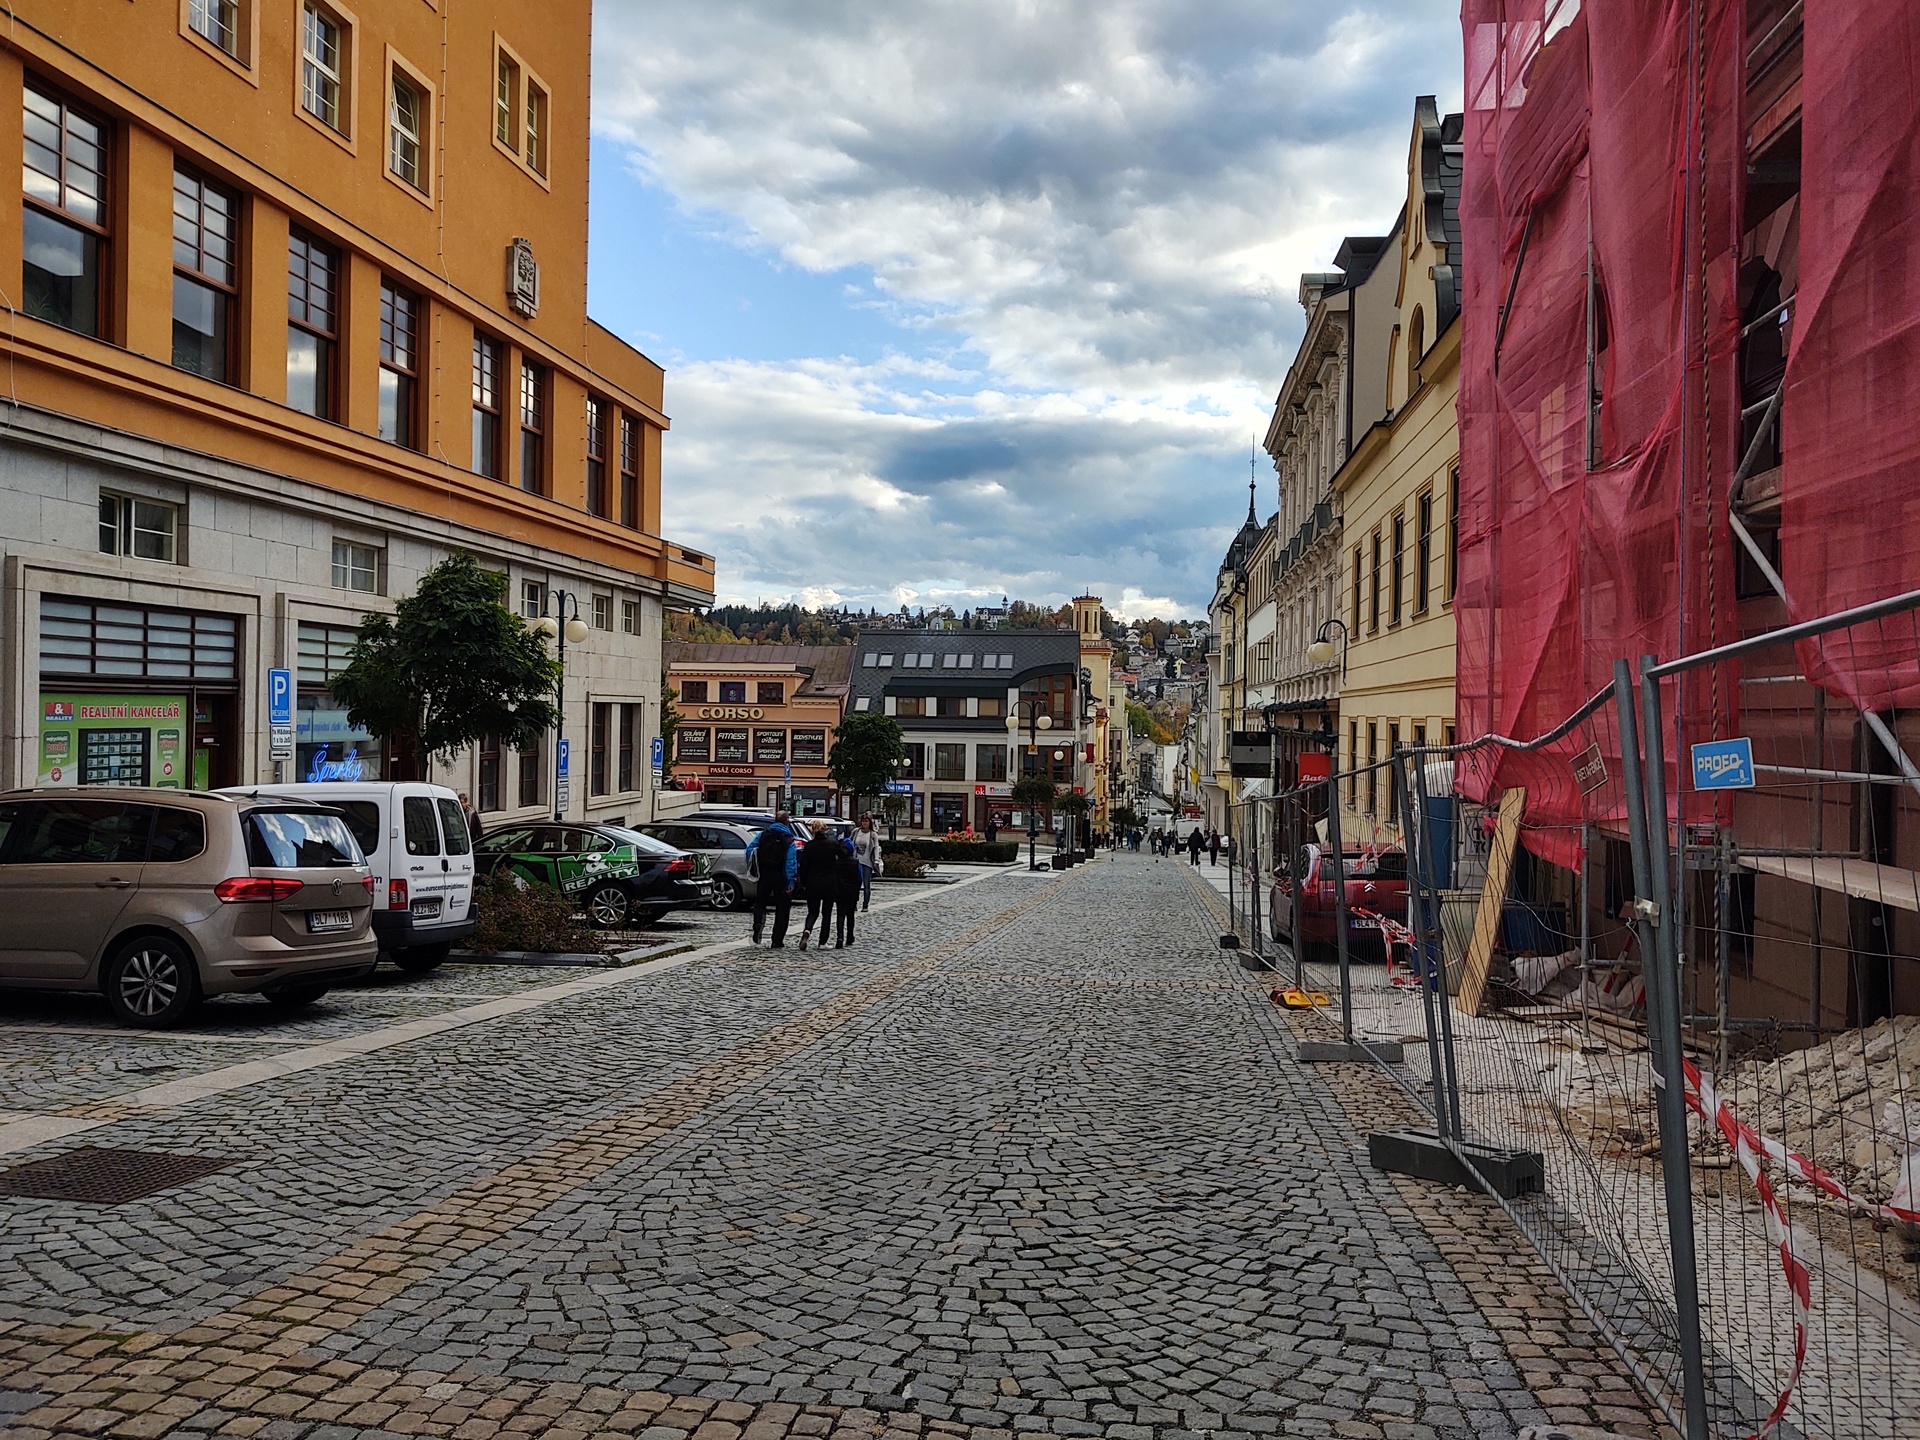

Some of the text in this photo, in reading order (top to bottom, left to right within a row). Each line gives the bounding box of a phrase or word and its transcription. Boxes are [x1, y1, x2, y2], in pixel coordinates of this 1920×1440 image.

[274, 675, 287, 706] P
[81, 702, 181, 719] REALITNÍ KANCELÁŘ
[698, 706, 765, 720] CORSO
[717, 732, 747, 740] FITNESS
[561, 744, 568, 766] P
[654, 741, 662, 760] P
[308, 743, 363, 783] Šperky
[710, 766, 730, 774] PASÁŽ
[314, 912, 329, 925] 5L7
